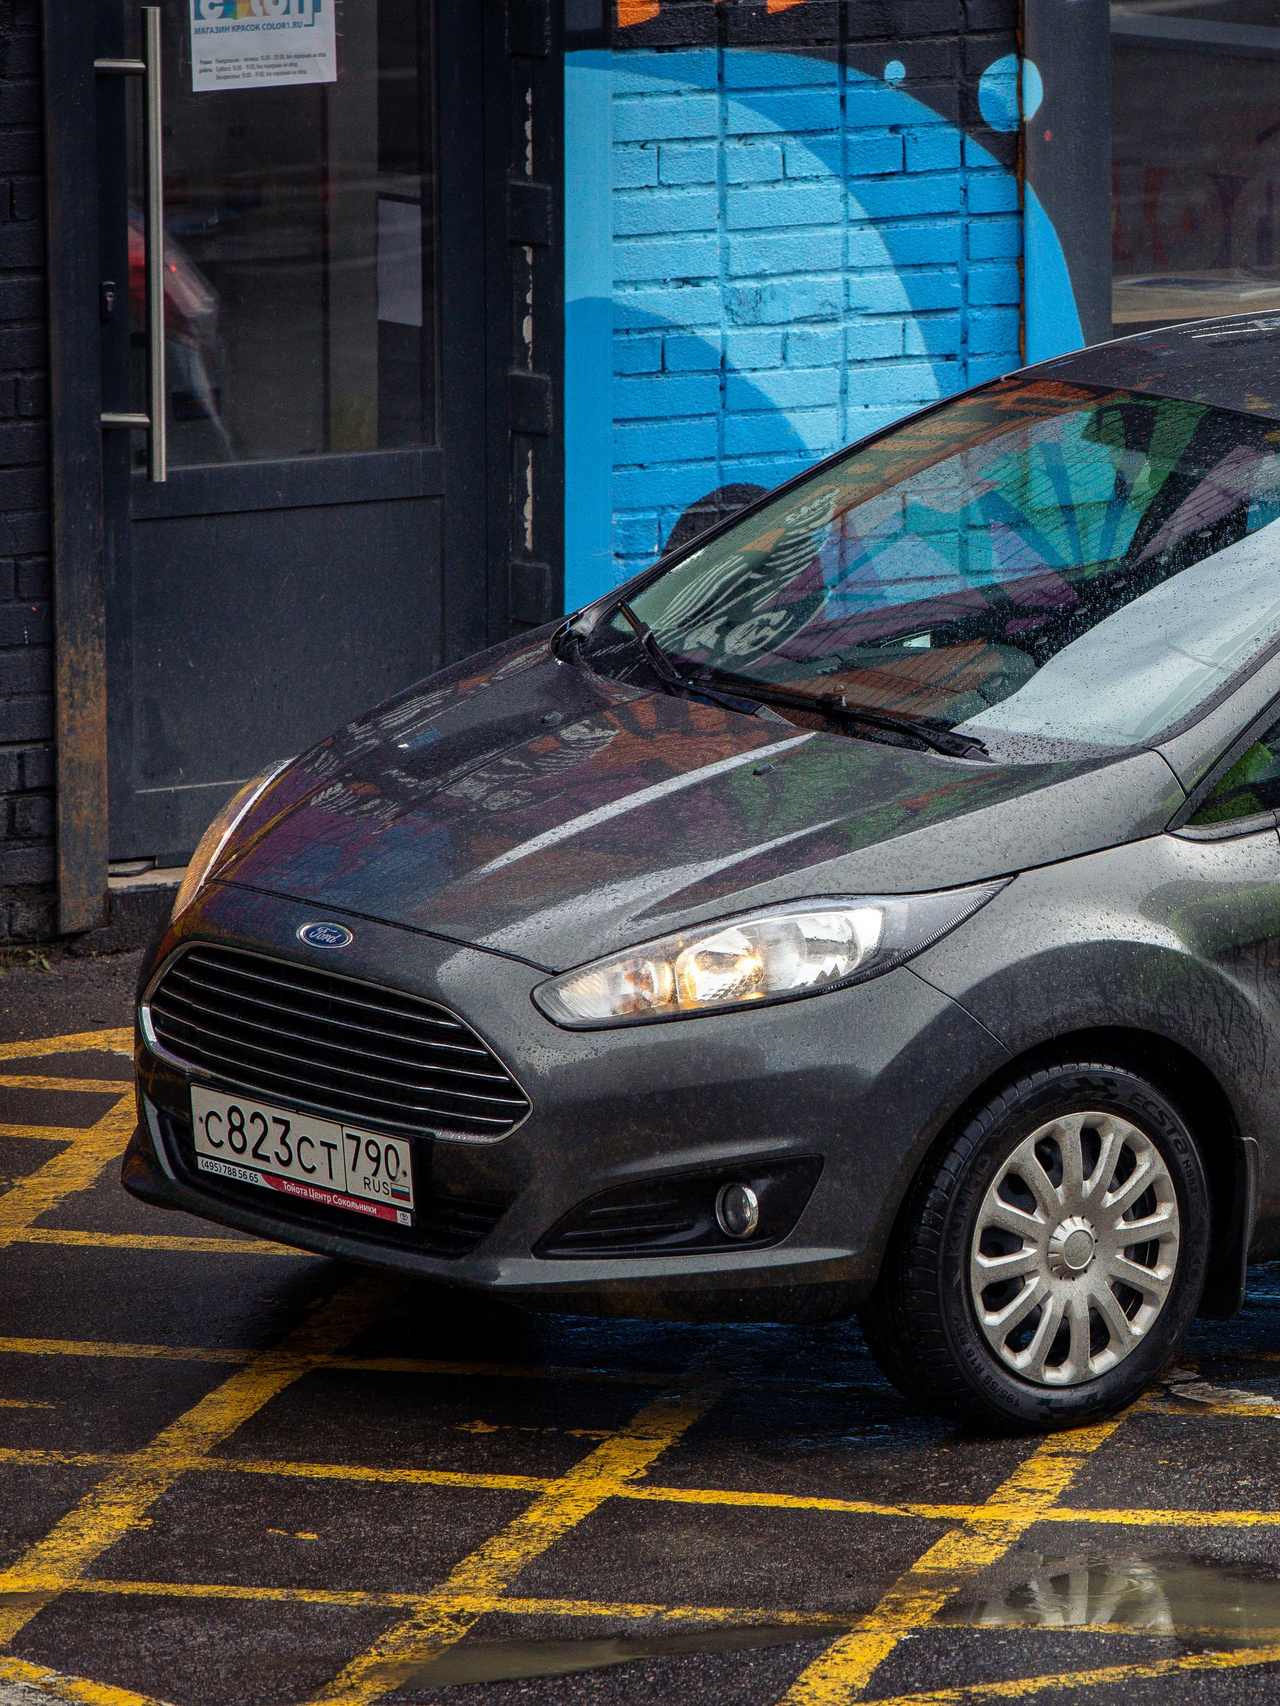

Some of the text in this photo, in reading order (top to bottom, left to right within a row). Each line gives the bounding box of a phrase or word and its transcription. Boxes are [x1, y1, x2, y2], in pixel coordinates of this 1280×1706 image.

[194, 21, 303, 35] МАГАЗИН КРАСОК COLOR1.RU
[308, 926, 342, 944] Ford
[345, 1133, 400, 1182] 790
[200, 1158, 259, 1183] (495) 788 56 65
[363, 1176, 390, 1196] RUS
[282, 1181, 377, 1215] Тойота Центр Сокольники
